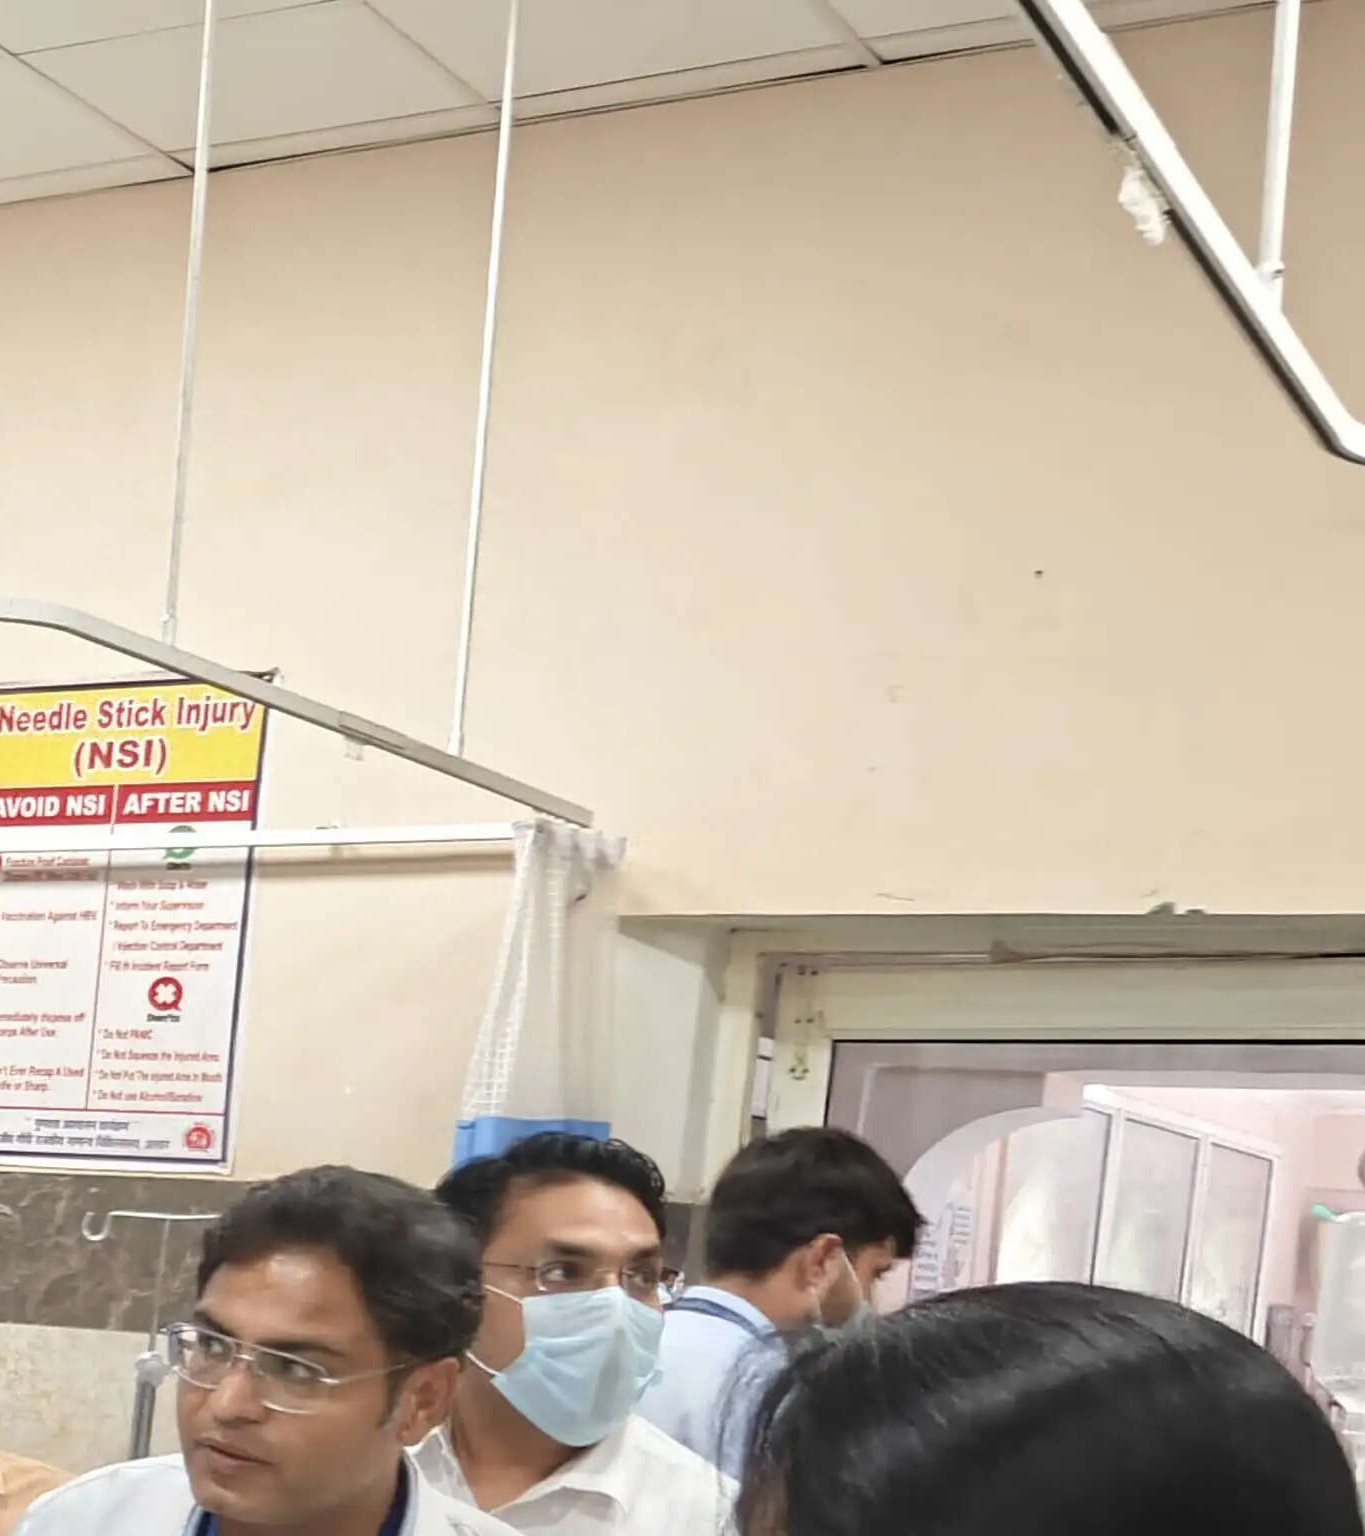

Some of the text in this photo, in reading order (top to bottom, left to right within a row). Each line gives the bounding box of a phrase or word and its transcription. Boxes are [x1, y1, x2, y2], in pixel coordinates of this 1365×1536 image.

[97, 698, 165, 729] Stick
[176, 695, 256, 732] Injury
[73, 738, 168, 778] (NSI)
[66, 794, 107, 816] NSI
[122, 789, 251, 815] AFTER NSI
